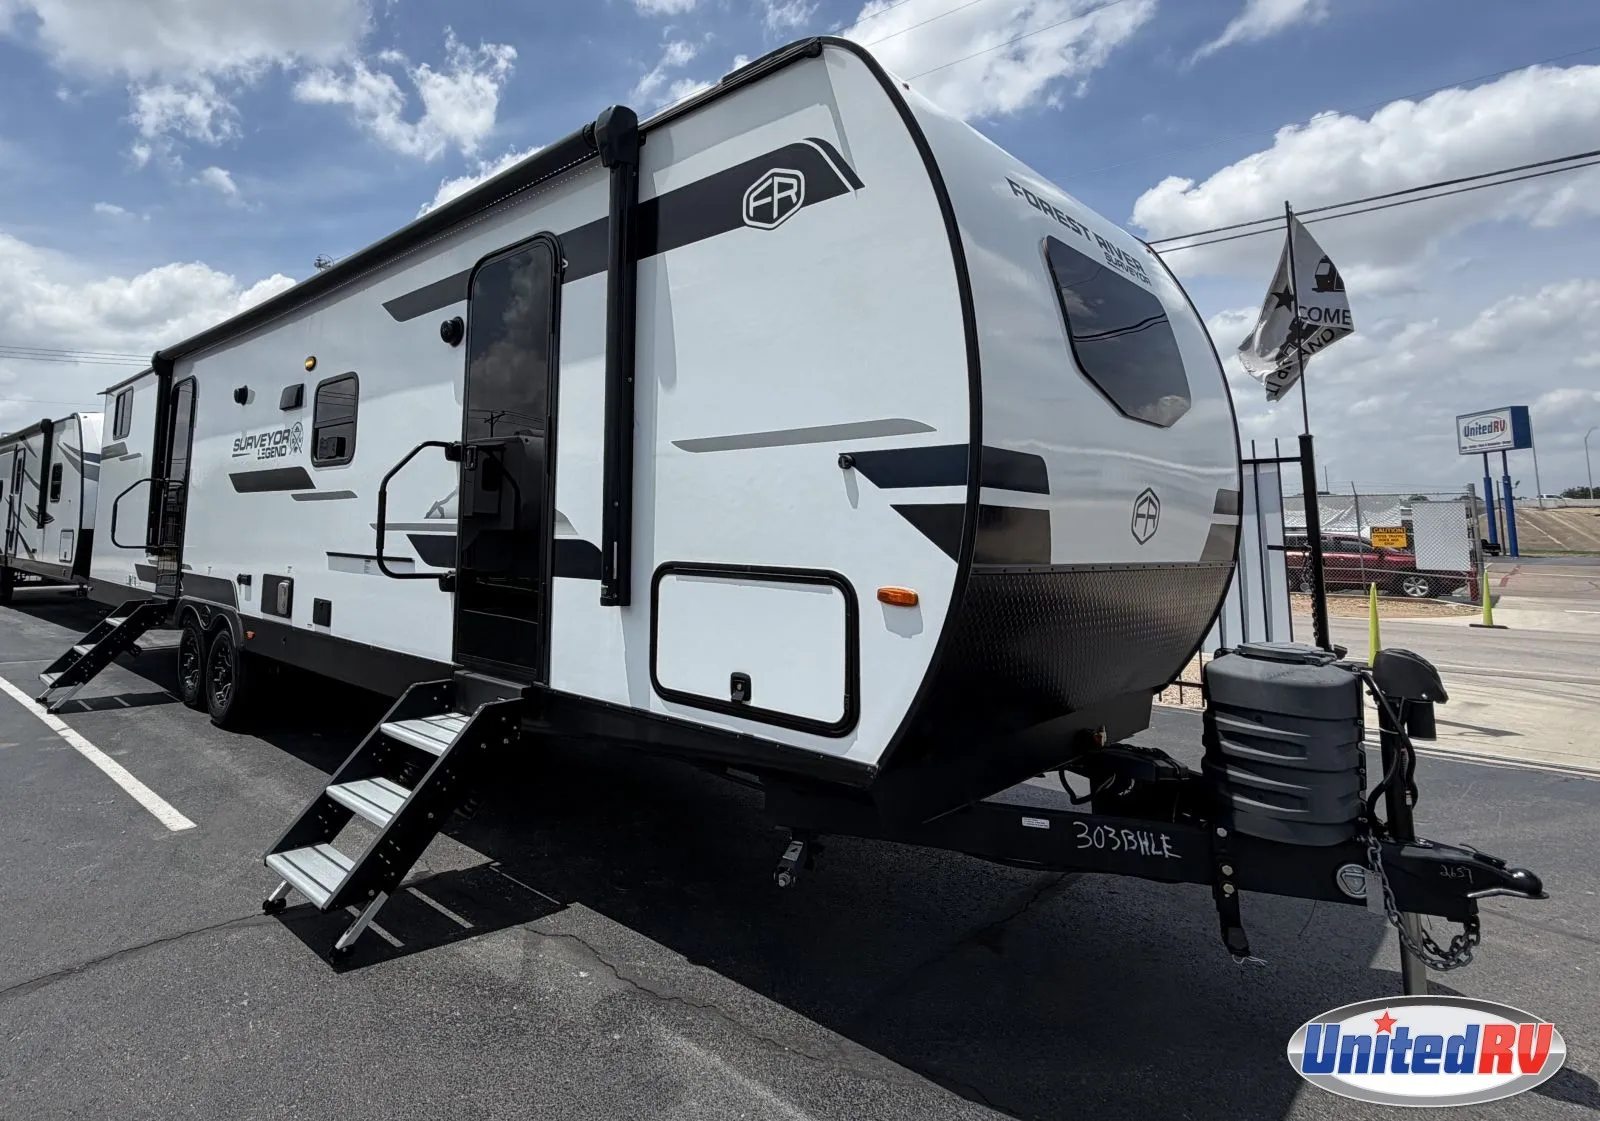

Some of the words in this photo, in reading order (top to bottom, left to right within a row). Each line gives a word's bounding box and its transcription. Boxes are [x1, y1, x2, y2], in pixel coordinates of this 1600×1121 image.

[748, 176, 798, 220] FR
[1004, 176, 1092, 242] FOREST
[1093, 232, 1148, 276] RIVER
[1103, 251, 1152, 286] SURVEYOR
[1298, 305, 1352, 326] COME
[232, 428, 291, 453] SURVEYOR
[1463, 419, 1506, 438] UnitedRV
[257, 445, 287, 460] LEGEND
[1072, 821, 1182, 859] 303BHLE
